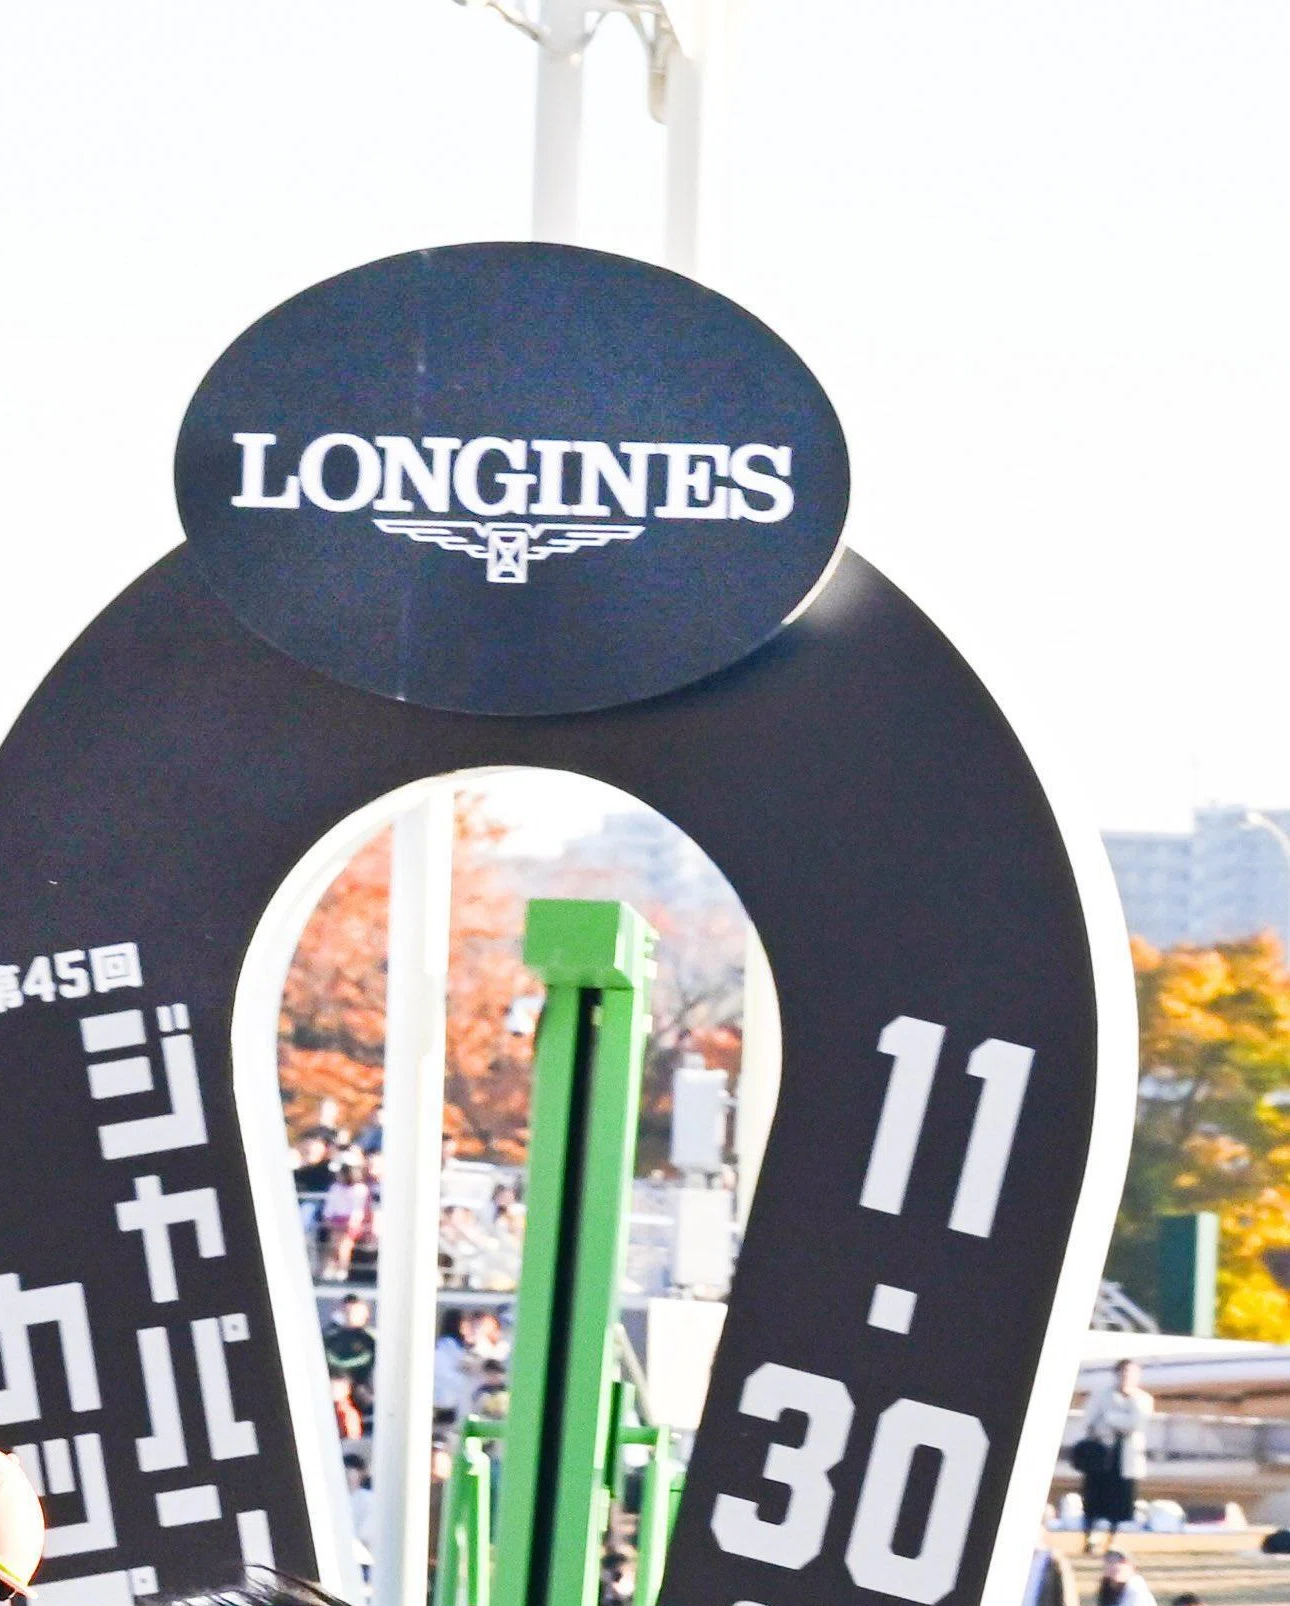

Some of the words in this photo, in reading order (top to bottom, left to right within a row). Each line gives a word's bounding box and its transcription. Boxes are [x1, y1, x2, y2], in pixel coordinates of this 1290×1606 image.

[231, 432, 794, 523] LONGINES
[860, 1016, 1036, 1238] 11
[711, 1361, 990, 1606] 30
